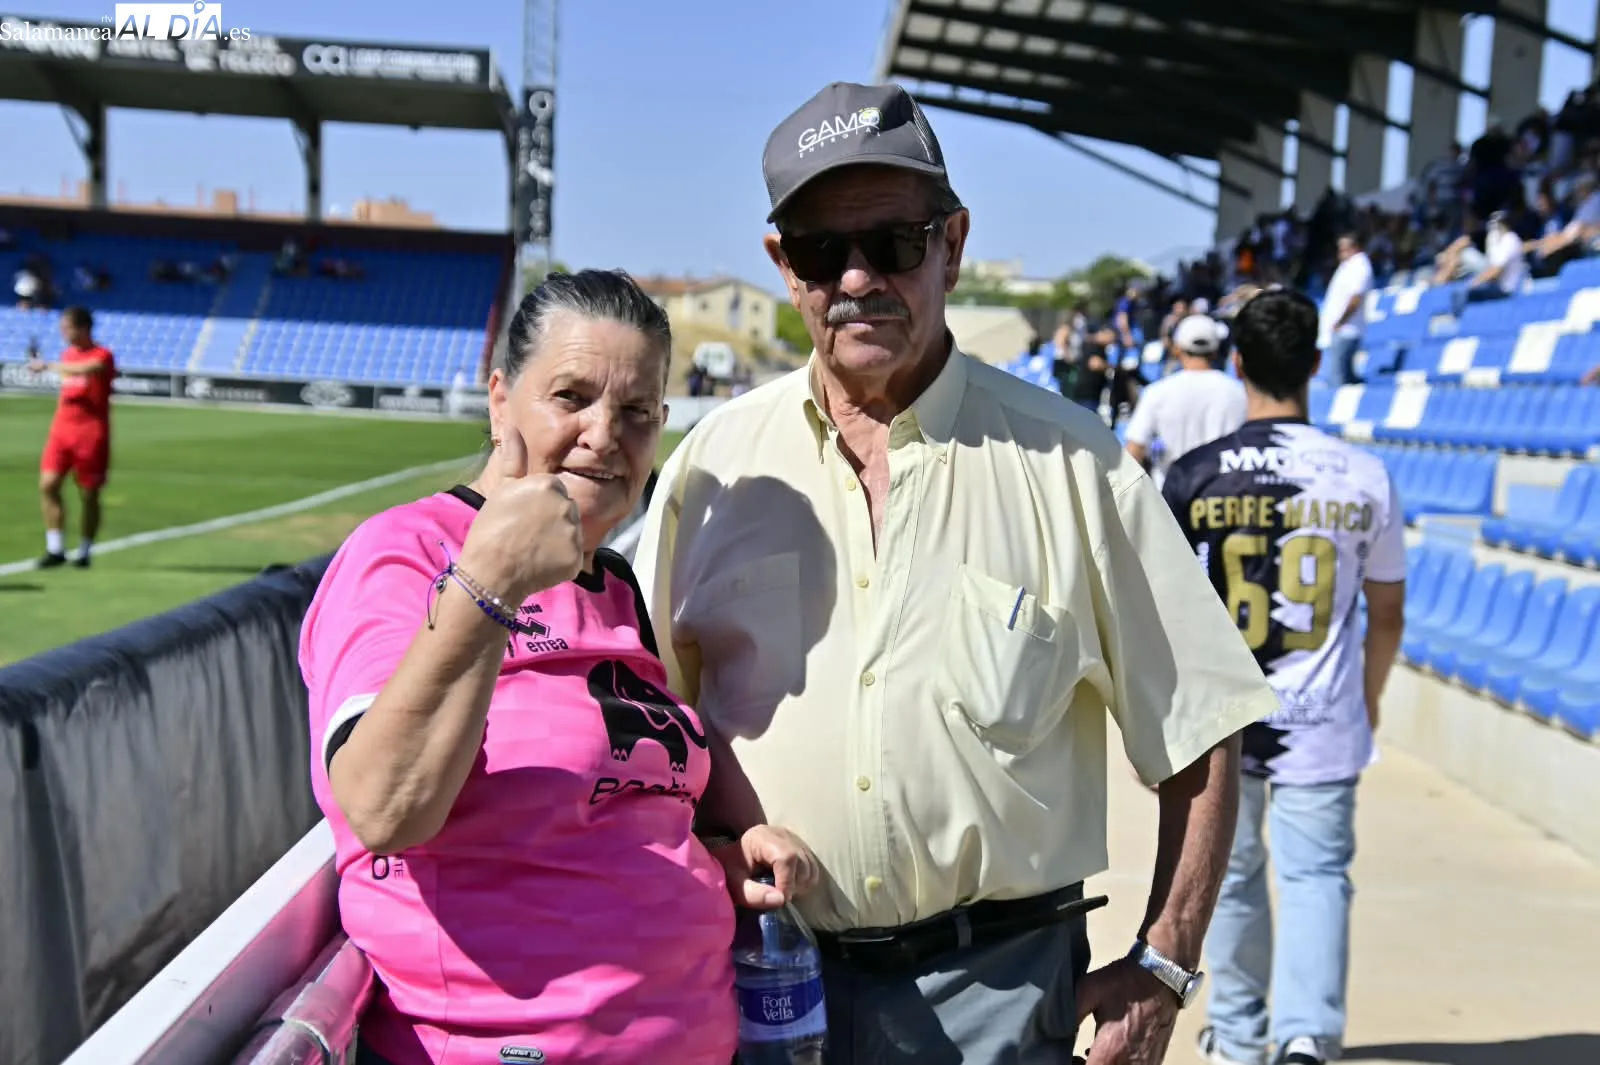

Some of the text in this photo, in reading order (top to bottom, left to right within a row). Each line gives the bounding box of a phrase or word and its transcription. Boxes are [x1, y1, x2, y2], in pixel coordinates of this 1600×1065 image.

[798, 107, 881, 149] GAMO
[1190, 495, 1373, 532] PERRE MARCO
[1221, 533, 1337, 653] 69
[762, 995, 793, 1008] Font
[763, 1007, 796, 1022] Vella
